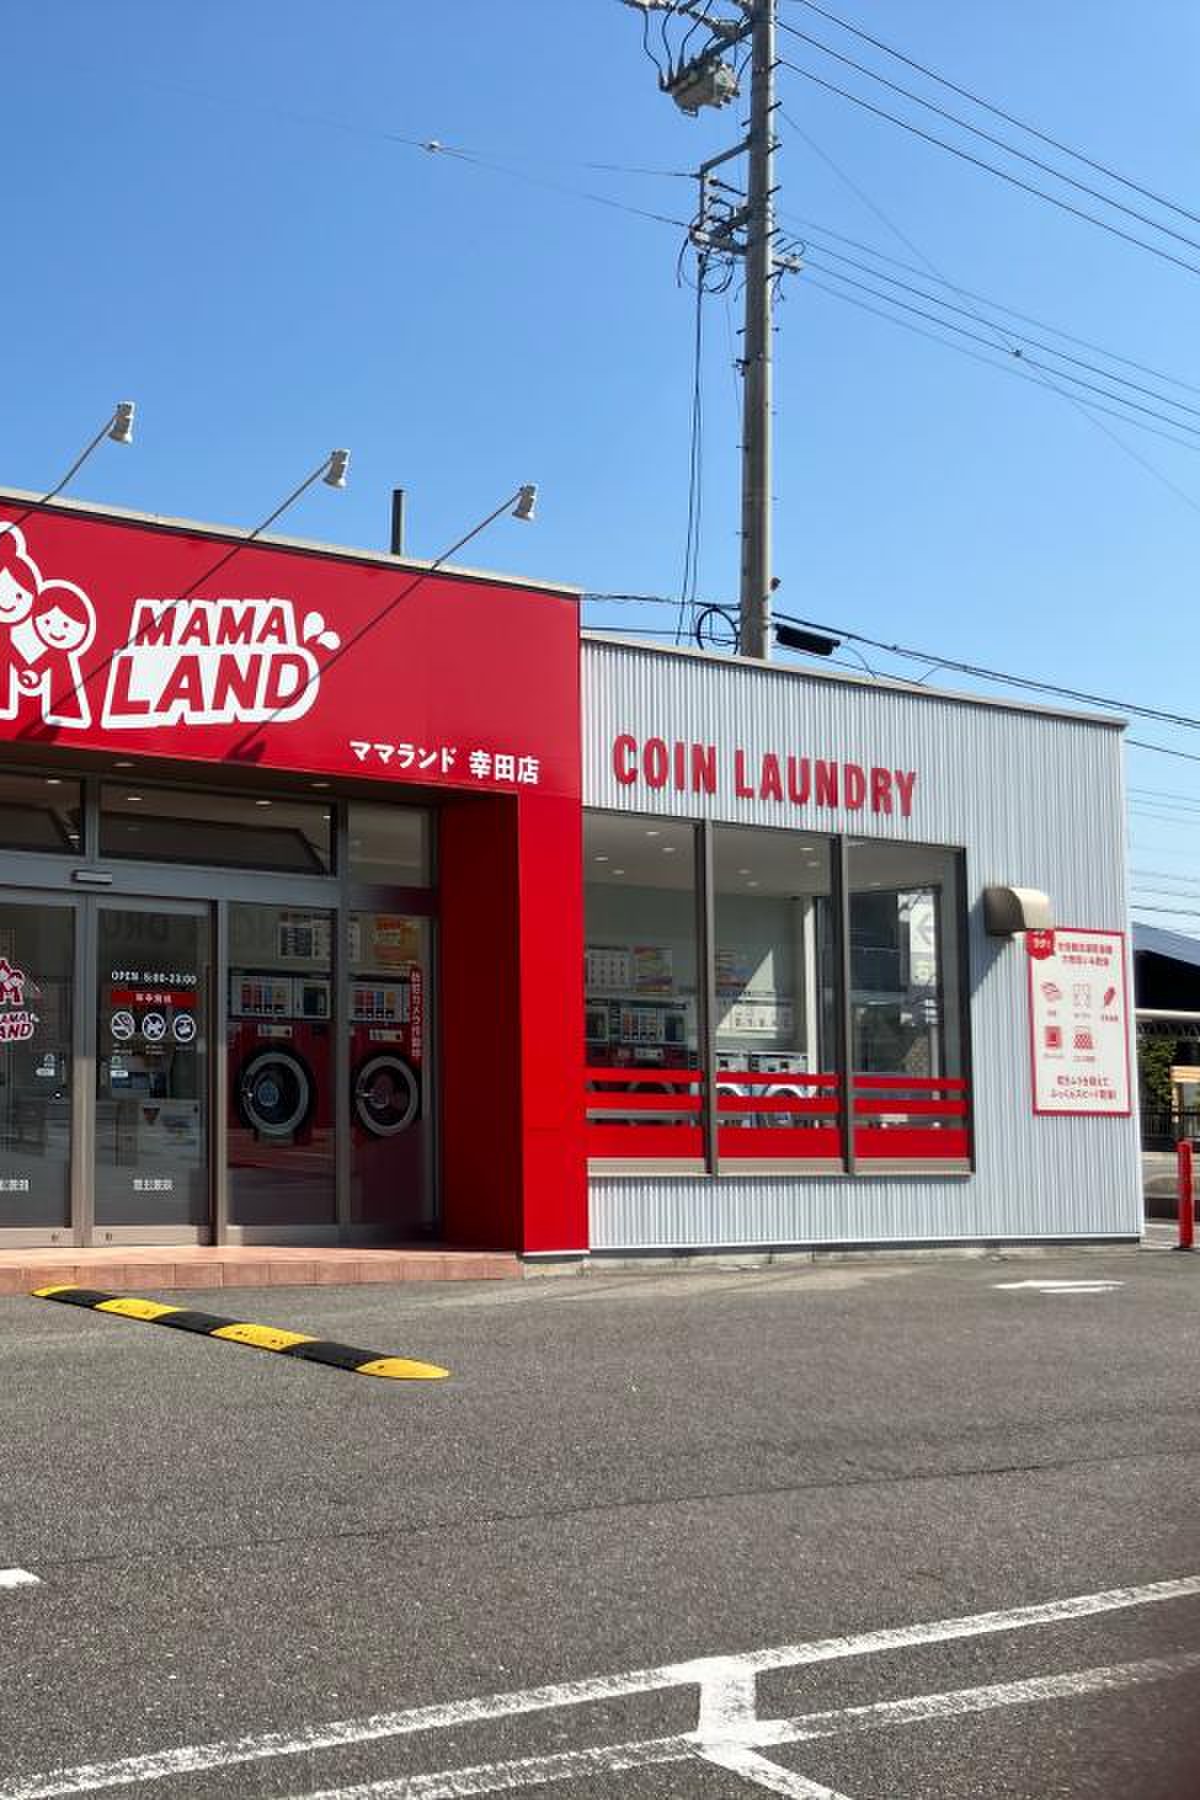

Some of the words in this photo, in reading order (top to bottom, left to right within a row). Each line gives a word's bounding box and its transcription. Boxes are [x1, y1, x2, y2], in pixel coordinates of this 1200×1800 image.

[134, 604, 288, 648] MAMA
[108, 652, 311, 716] LAND
[349, 740, 458, 773] ママランド
[468, 749, 540, 785] 幸田店
[612, 733, 718, 795] COIN
[734, 748, 918, 818] LAUNDRY
[111, 969, 140, 982] OPEN
